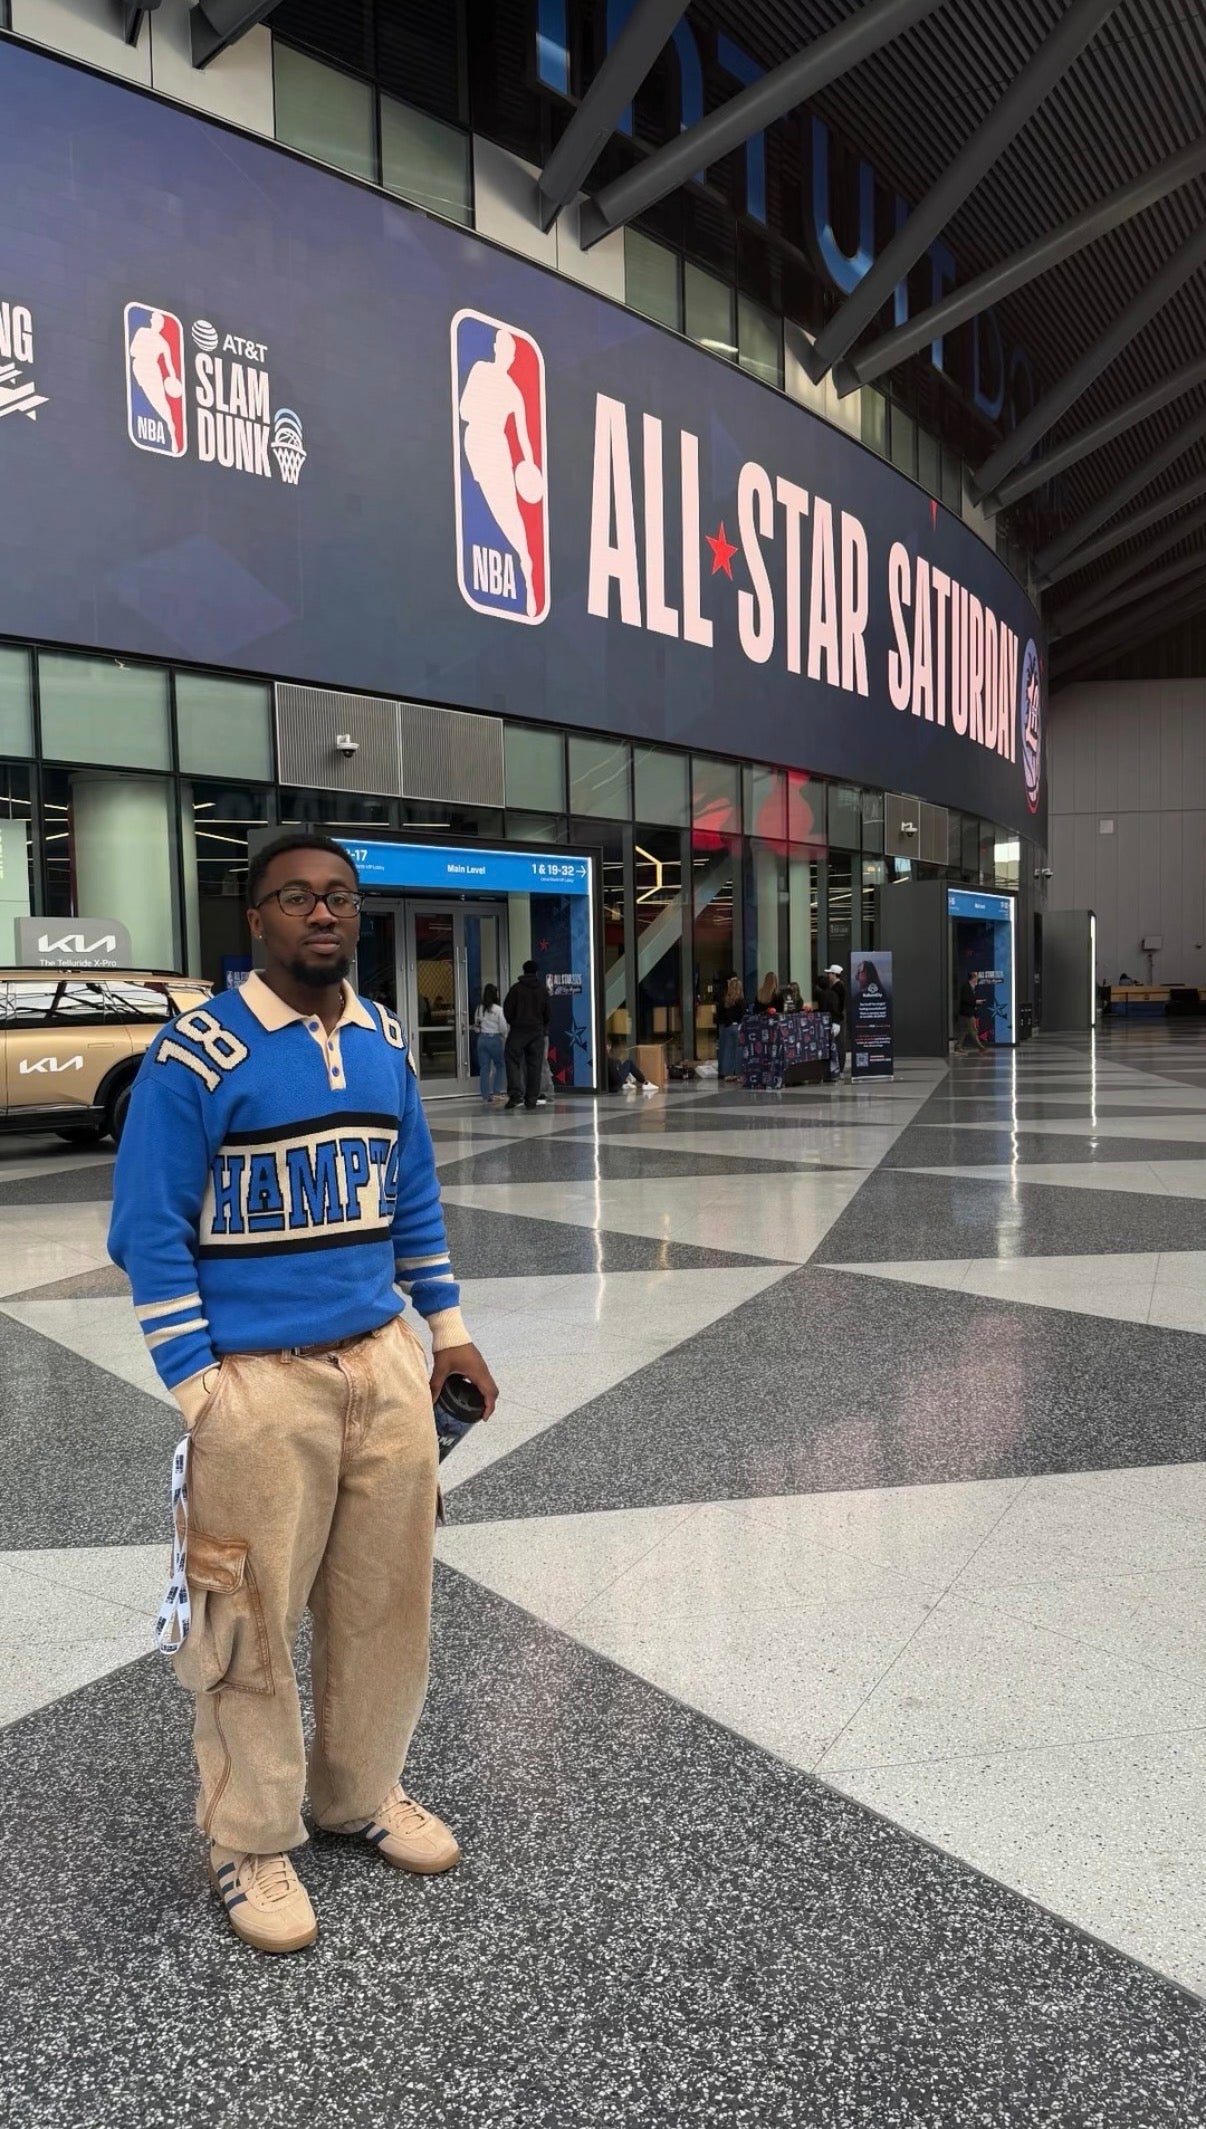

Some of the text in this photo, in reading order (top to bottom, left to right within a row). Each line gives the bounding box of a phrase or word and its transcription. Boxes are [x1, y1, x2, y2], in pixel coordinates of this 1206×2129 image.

[223, 334, 267, 362] AT&T
[195, 352, 271, 425] SLAM
[138, 416, 166, 444] NBA
[197, 407, 272, 478] DUNK
[473, 544, 518, 600] NBA
[588, 392, 1019, 764] ALL STAR SATURDAY
[447, 864, 486, 875] Main Level
[532, 864, 575, 876] 1 & 19-32
[38, 934, 116, 952] KIA
[40, 959, 117, 968] The Telluride X-Pro
[19, 1055, 83, 1074] KIA
[155, 1009, 250, 1093] 18
